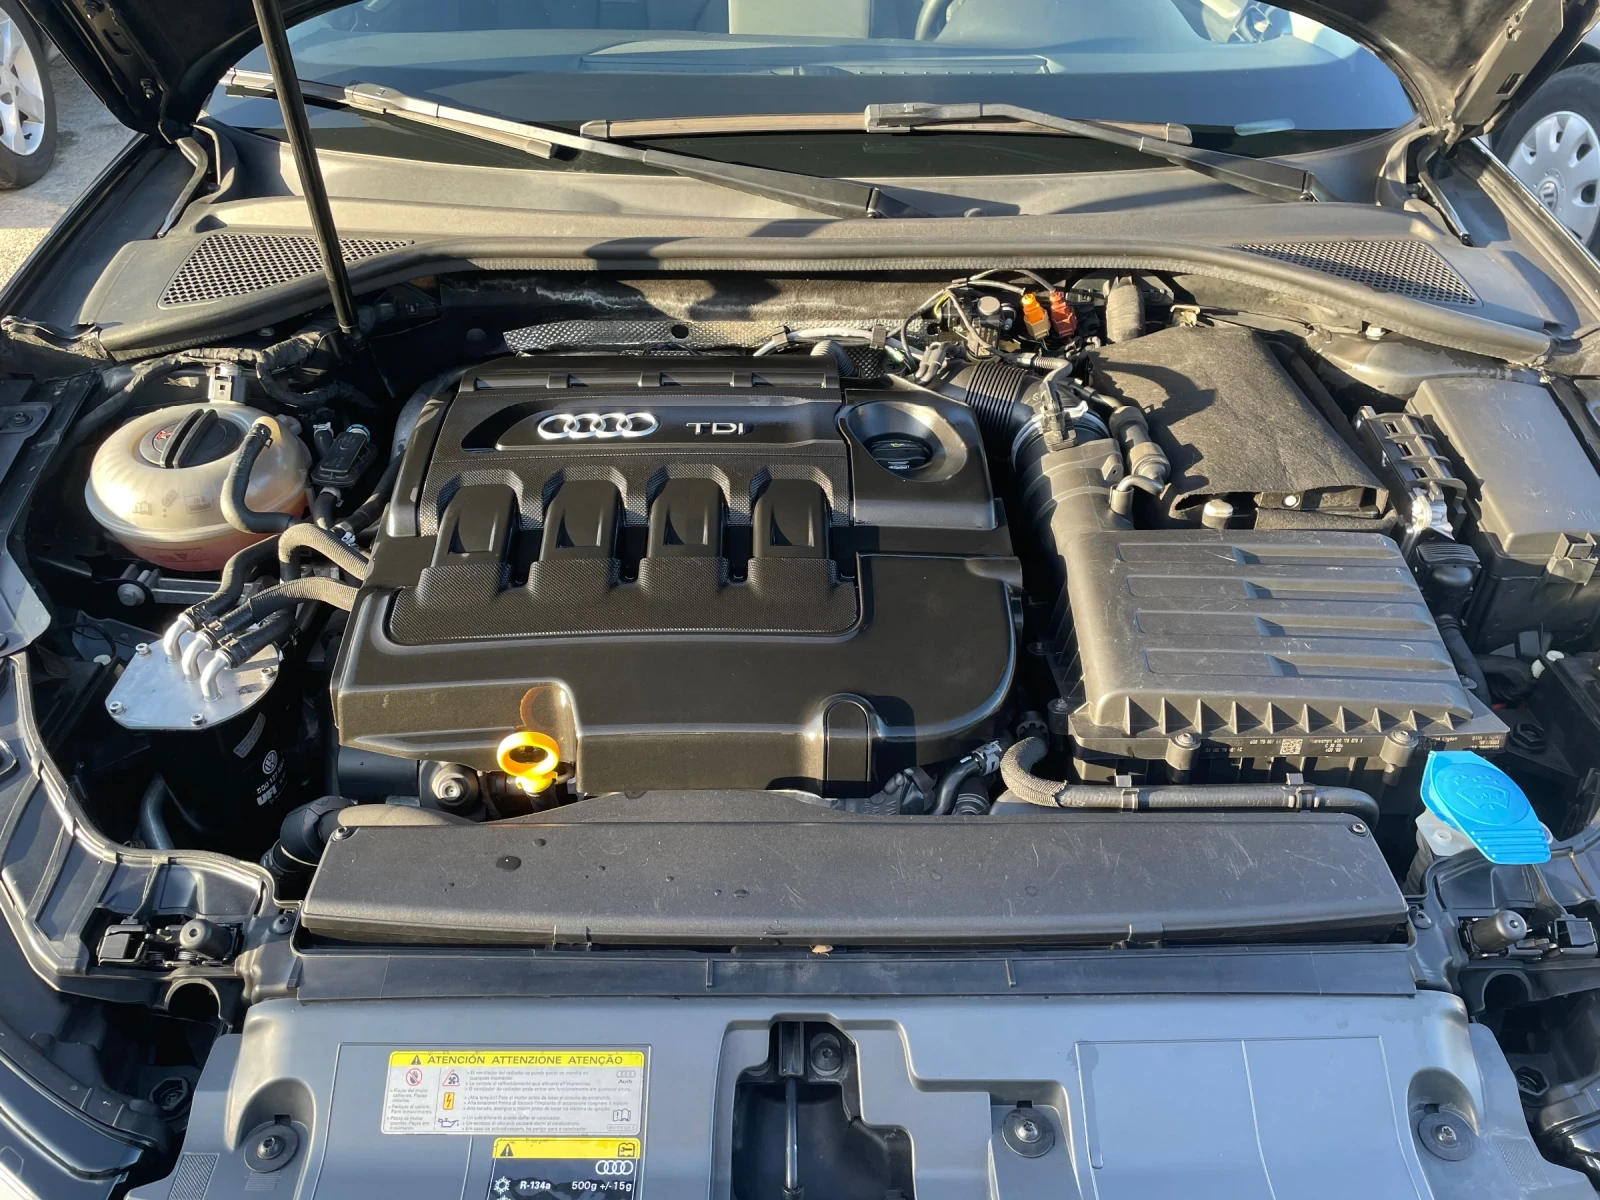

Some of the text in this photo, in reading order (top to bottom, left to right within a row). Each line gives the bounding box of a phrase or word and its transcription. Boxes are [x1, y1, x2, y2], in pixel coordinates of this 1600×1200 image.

[686, 422, 744, 436] TDI
[256, 784, 277, 806] UFI
[427, 1055, 623, 1066] ATENCIÓN ATTENZIONE ATENÇÃO
[519, 1180, 551, 1190] R-134a
[571, 1181, 597, 1192] 500g
